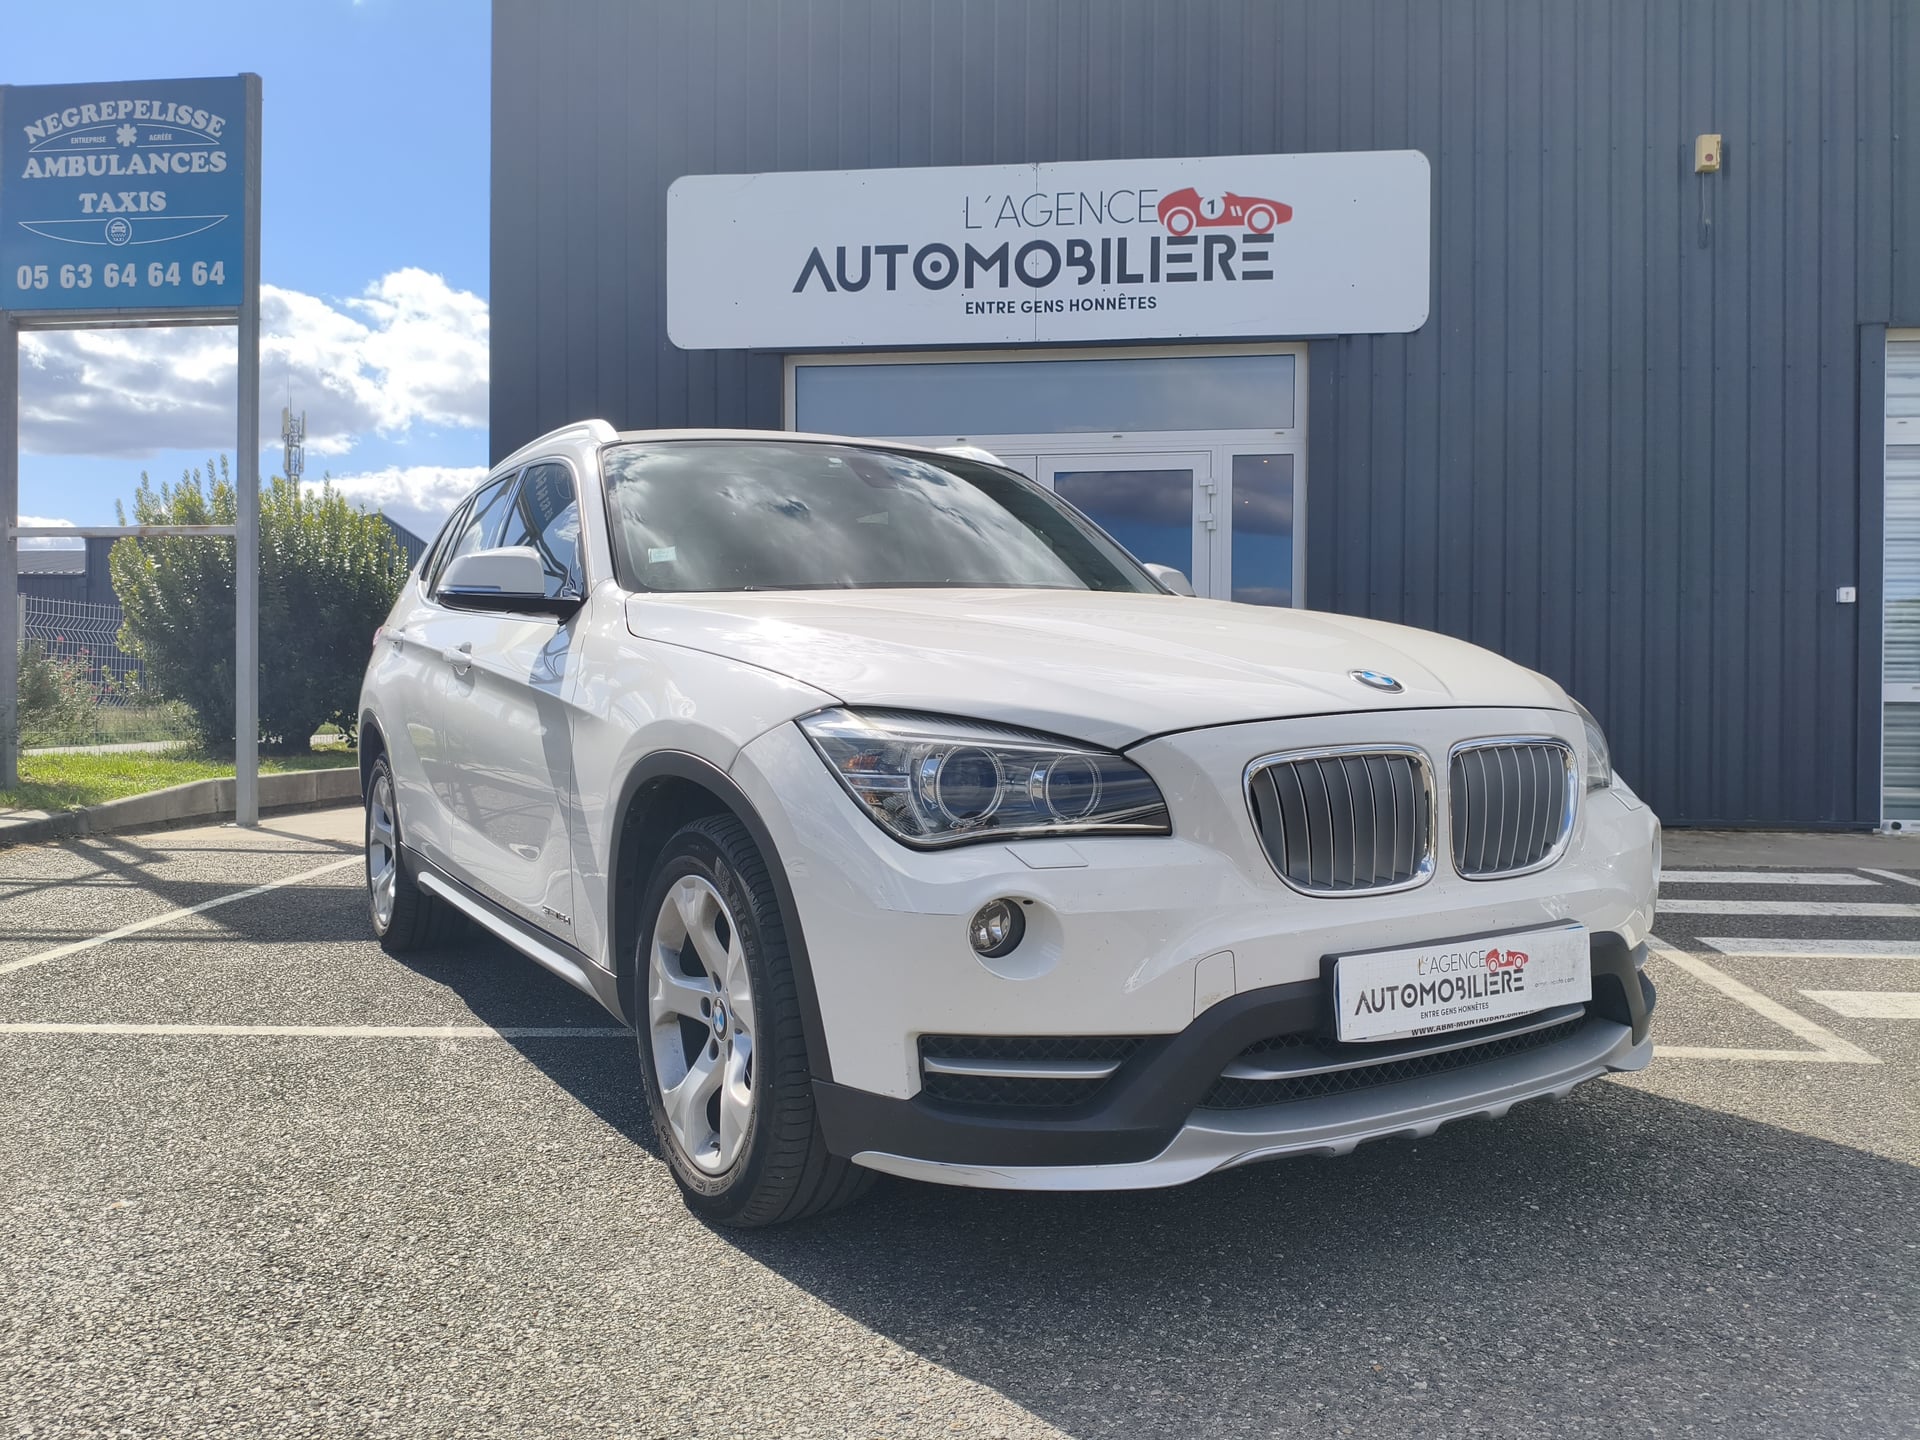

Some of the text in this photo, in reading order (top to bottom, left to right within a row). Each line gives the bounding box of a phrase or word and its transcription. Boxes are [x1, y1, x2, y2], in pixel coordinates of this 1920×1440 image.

[24, 100, 226, 144] NEGREPELISSE
[70, 135, 107, 144] ENTREPRISE
[22, 152, 227, 179] AMBULANCES
[79, 191, 167, 213] TAXIS
[965, 189, 1158, 229] L'AGENCE
[1206, 199, 1216, 215] 1
[17, 261, 225, 290] 05 63 64 64 64
[965, 293, 1158, 315] ENTRE GENS HONNÊTES
[1420, 1001, 1489, 1020] ENTRE GENS HONNÊTES
